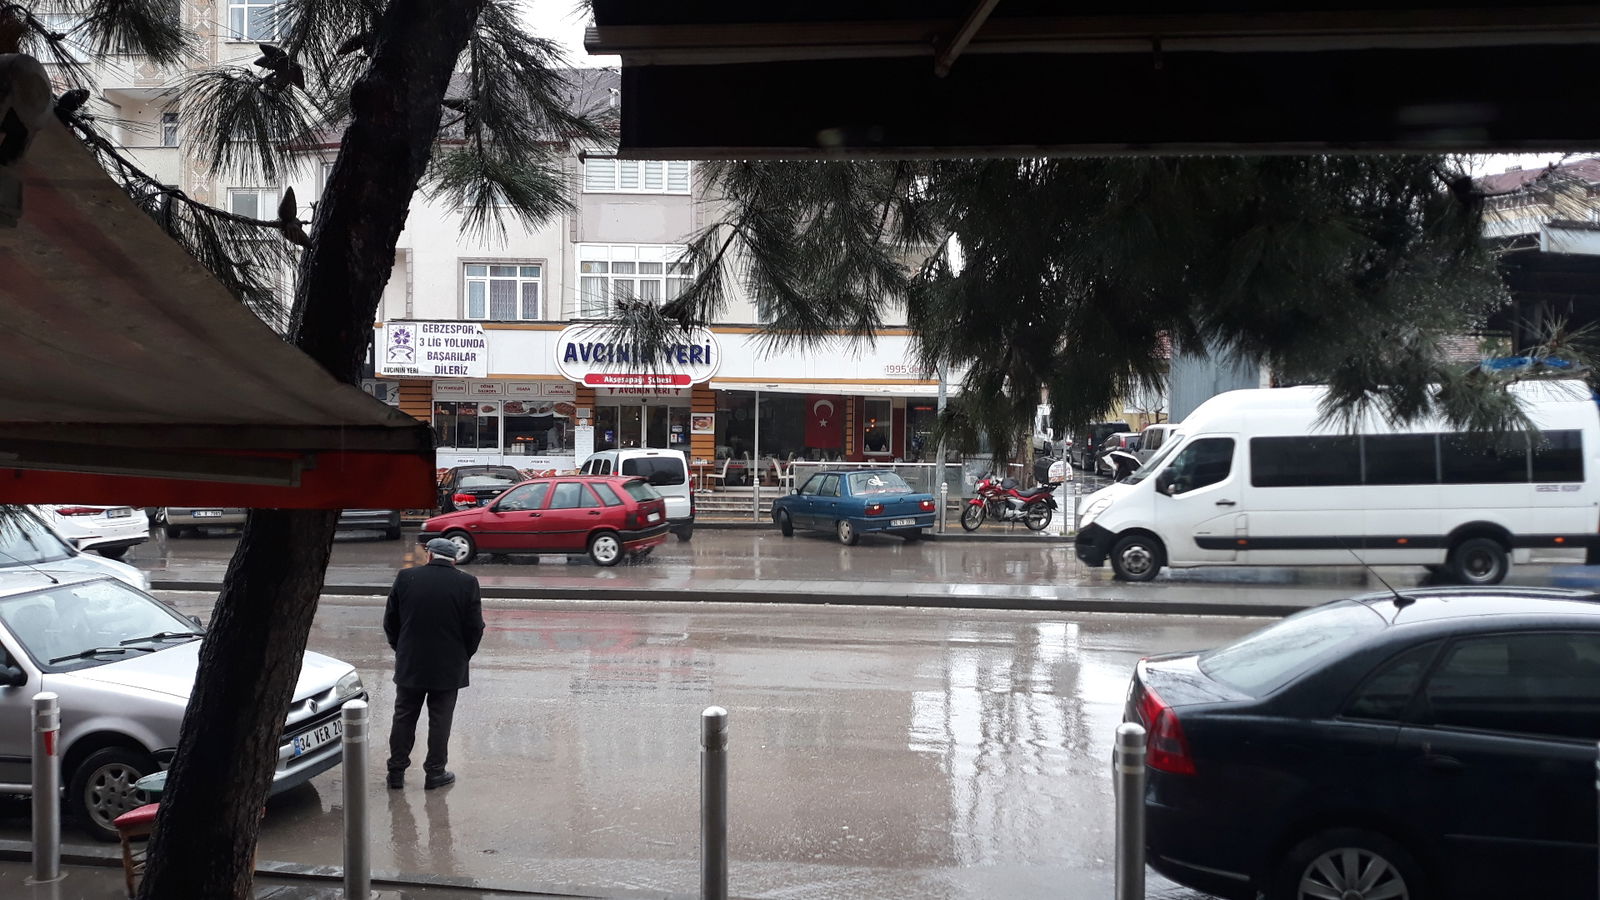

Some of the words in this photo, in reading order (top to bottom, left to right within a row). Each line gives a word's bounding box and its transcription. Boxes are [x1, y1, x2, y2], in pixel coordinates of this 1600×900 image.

[419, 337, 425, 347] 3
[427, 336, 441, 347] LİG
[444, 338, 485, 348] YOLUNDA
[427, 351, 477, 362] BAŞARILAR
[664, 338, 711, 364] YERİ
[434, 363, 468, 375] DİLERİZ
[300, 735, 310, 751] 34
[314, 726, 330, 744] VER
